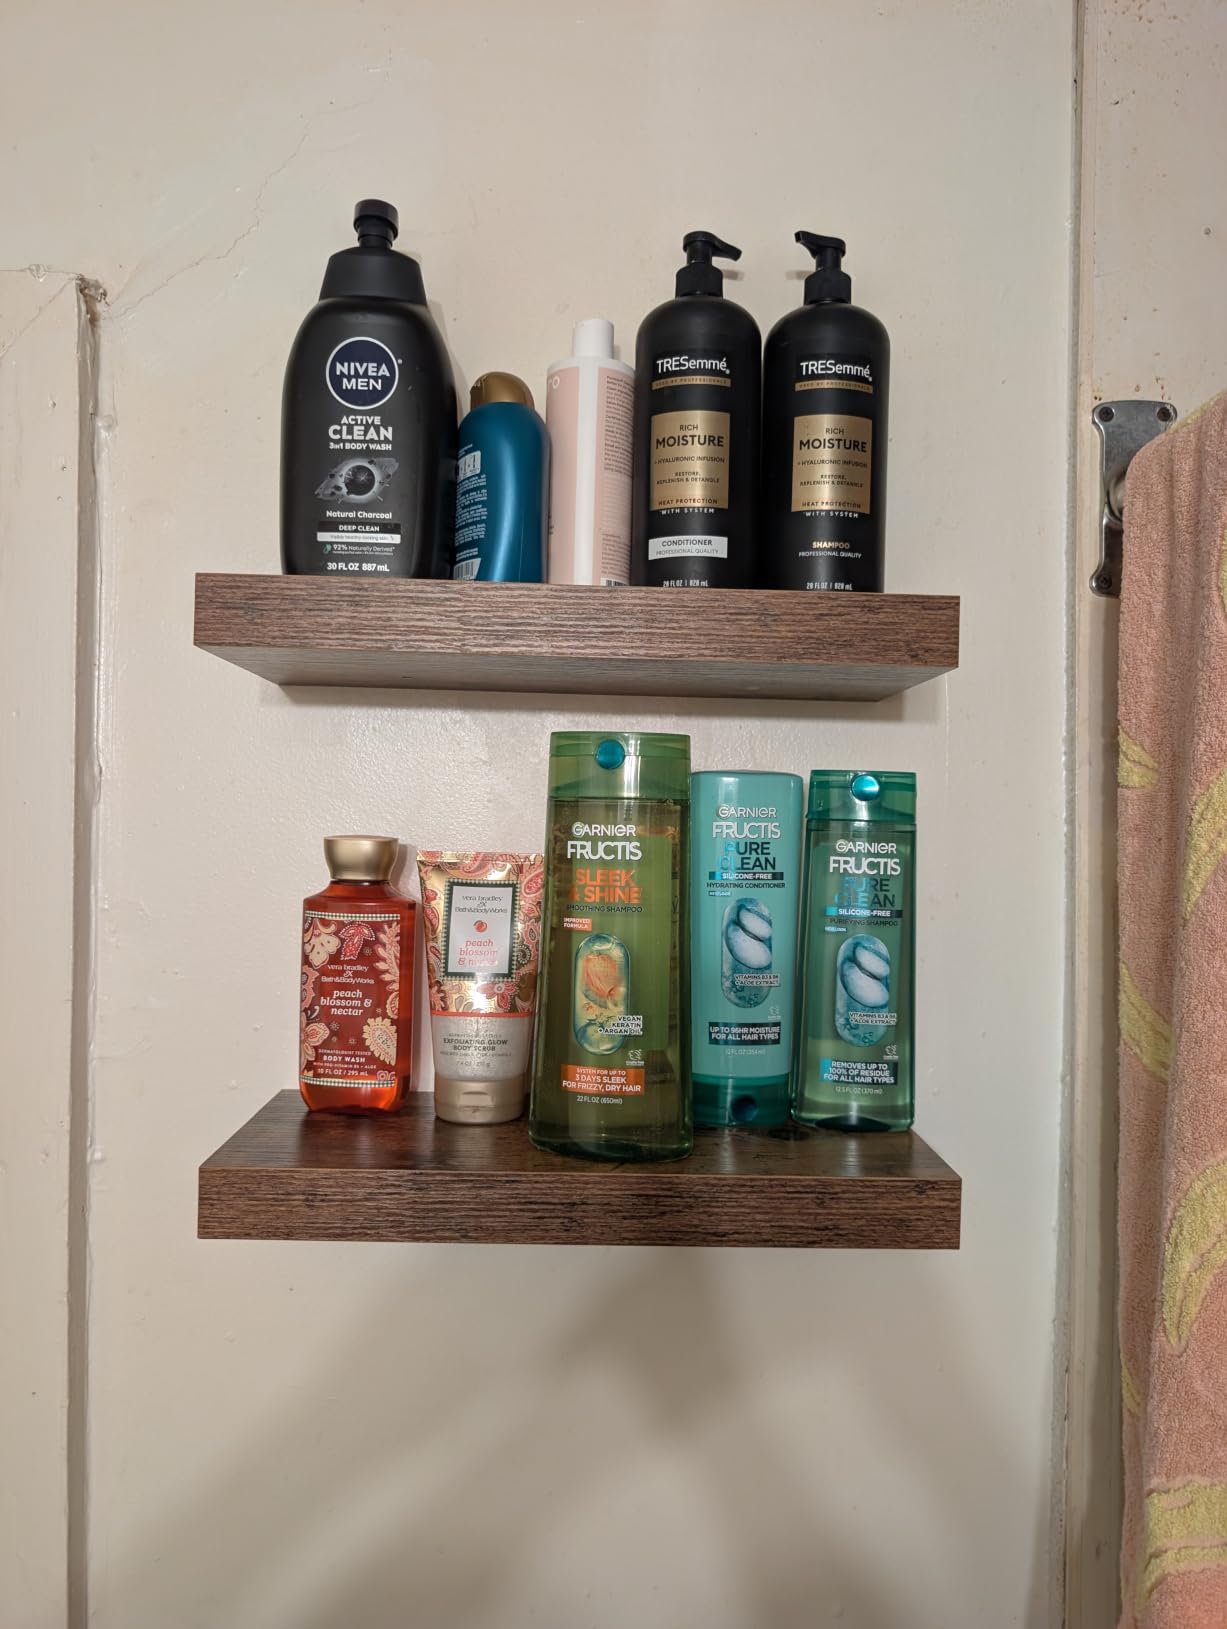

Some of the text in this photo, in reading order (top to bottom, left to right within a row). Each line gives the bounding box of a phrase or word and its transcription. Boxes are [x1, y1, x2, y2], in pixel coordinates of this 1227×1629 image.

[336, 362, 390, 376] NIVEA
[342, 378, 382, 390] MEN
[341, 416, 381, 425] ACTIVE
[328, 426, 392, 441] CLEAN
[656, 435, 724, 450] MOISTURE
[800, 438, 867, 452] MOISTURE
[842, 460, 868, 468] INFUSION
[657, 477, 684, 485] REPLENISH
[326, 510, 392, 519] Natural Charcoal
[362, 563, 376, 571] 887
[717, 804, 776, 820] GARNIER
[572, 822, 636, 837] GARNIER
[712, 822, 781, 839] FRUCTIS
[567, 841, 642, 860] FRUCTIS
[725, 842, 771, 855] PURE
[836, 839, 897, 854] GARNIER
[720, 857, 776, 871] CLEAN
[830, 856, 901, 875] FRUCTIS
[576, 868, 635, 886] SLEEK
[584, 886, 641, 903] SHINE
[465, 939, 493, 948] peach
[344, 964, 369, 973] bradley
[333, 989, 363, 999] peach
[320, 997, 372, 1008] blossom &
[331, 1007, 363, 1016] nectar
[832, 1061, 866, 1070] REMOVES
[603, 1076, 626, 1084] SLEEK
[578, 1083, 604, 1092] FRIZZY,
